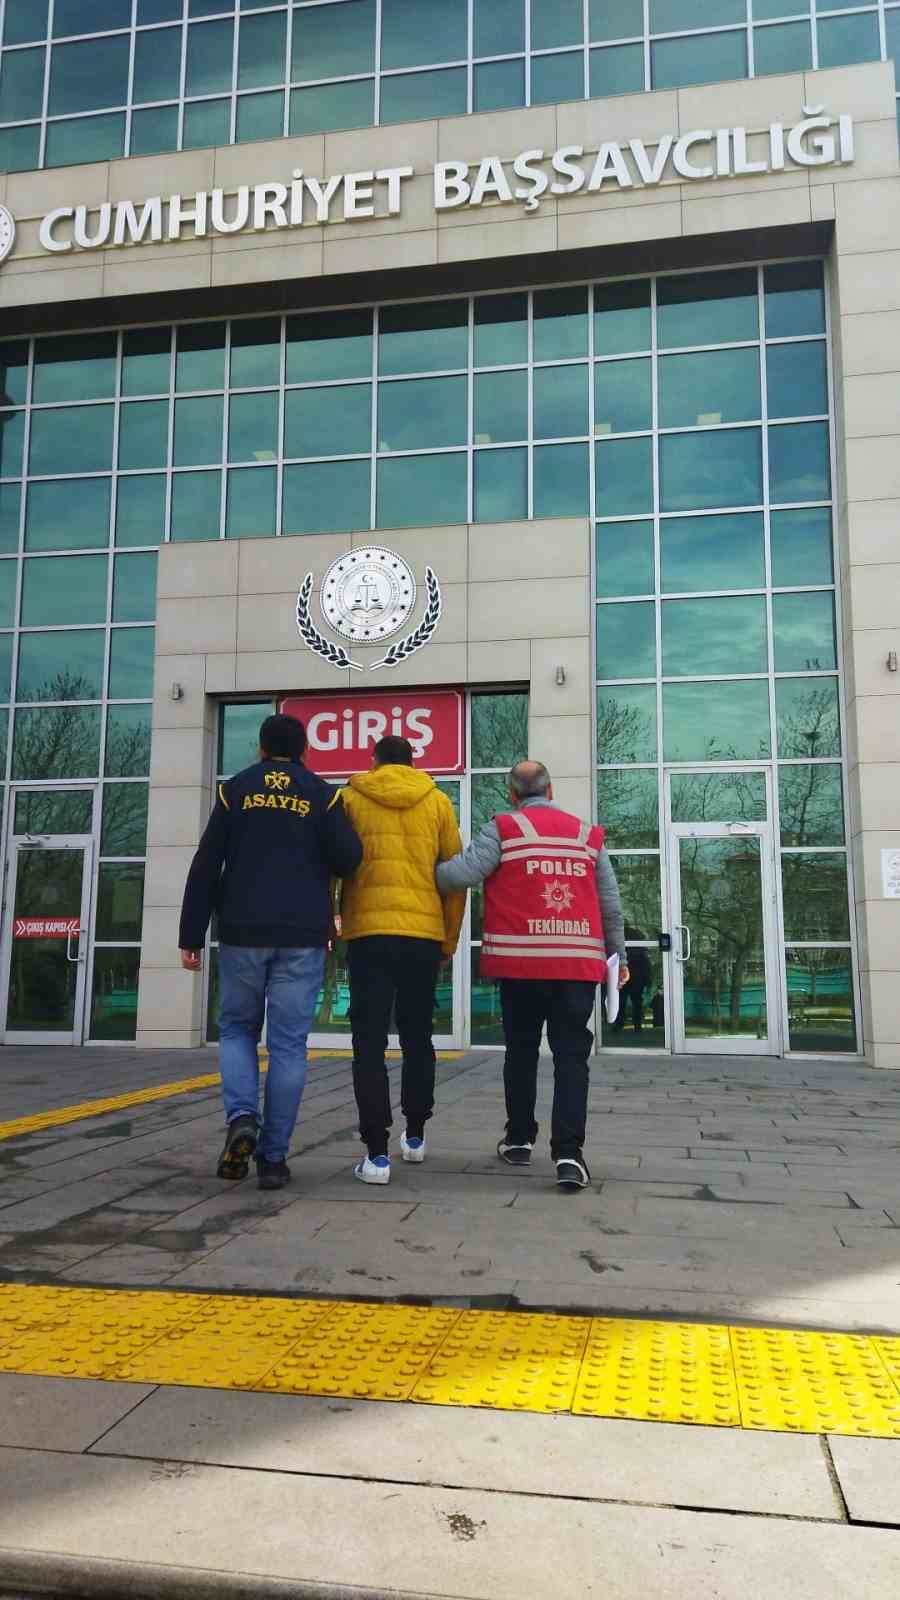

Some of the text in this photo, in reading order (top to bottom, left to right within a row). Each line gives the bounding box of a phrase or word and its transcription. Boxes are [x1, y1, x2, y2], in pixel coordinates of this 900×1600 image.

[39, 103, 855, 253] CUMHURİYET BAŞSAVCILIĞI
[241, 793, 311, 818] ASAYİŞ
[526, 858, 588, 877] POLİS
[527, 915, 591, 936] TEKİRDAĞ
